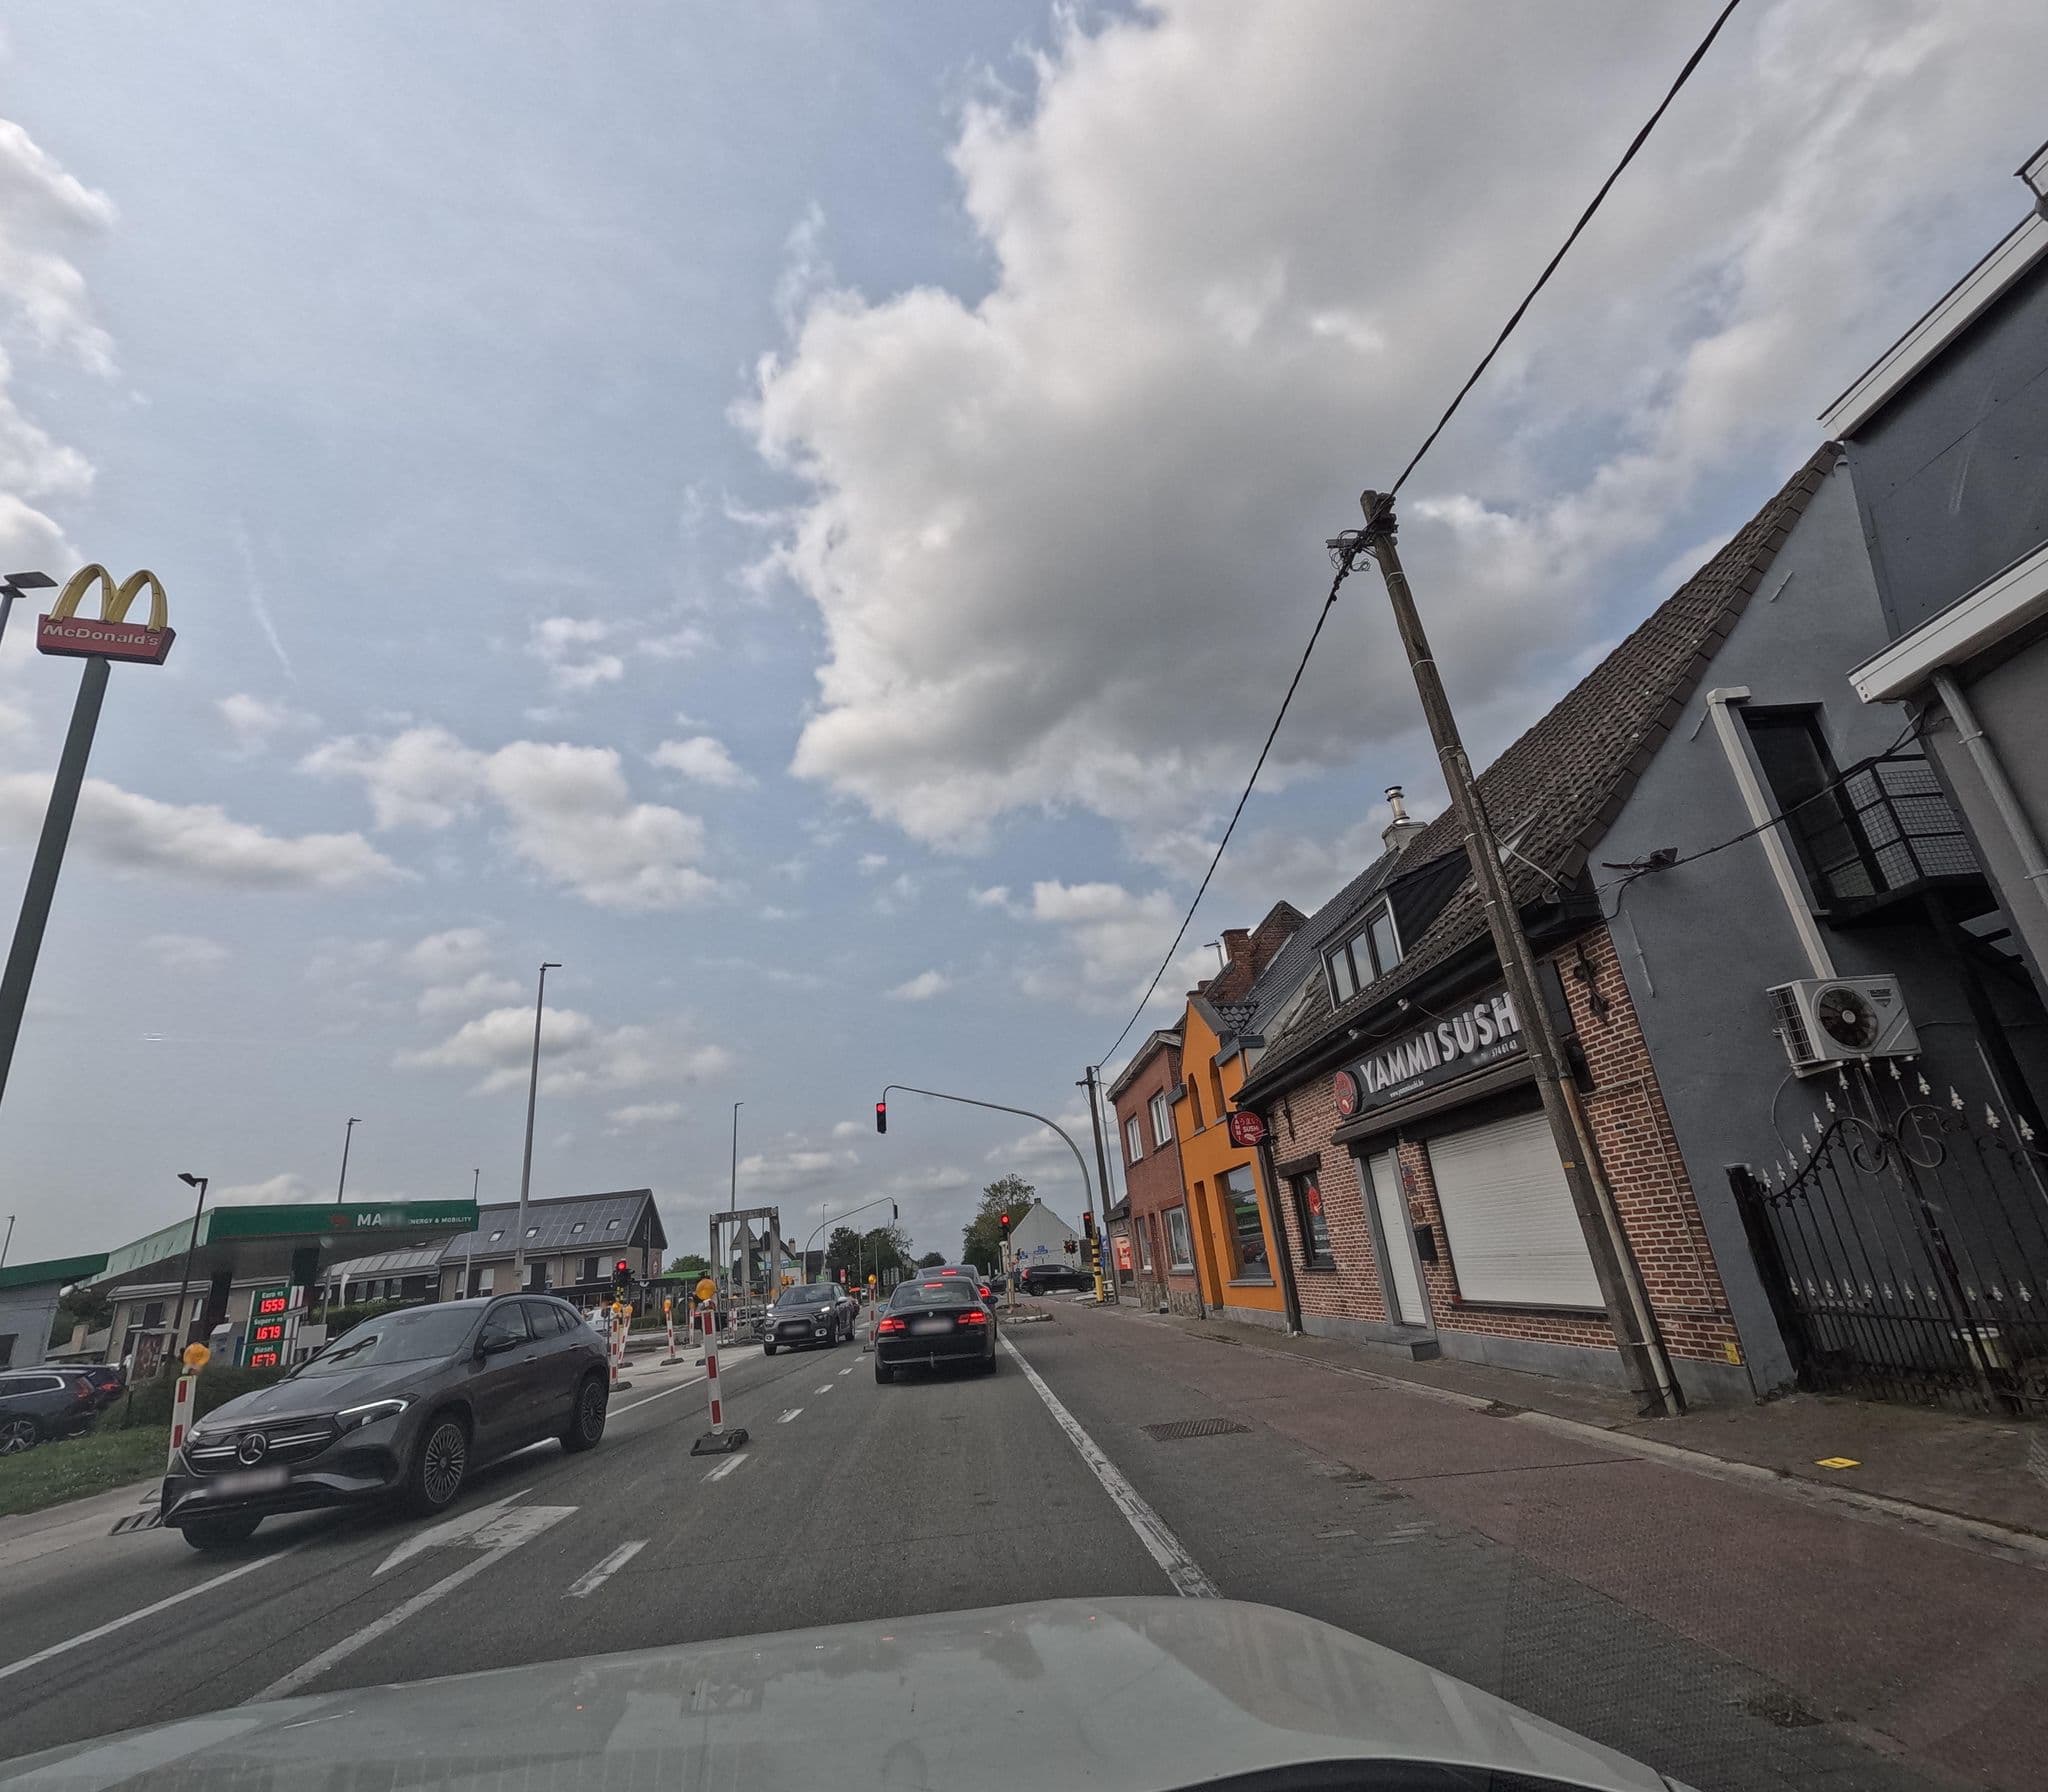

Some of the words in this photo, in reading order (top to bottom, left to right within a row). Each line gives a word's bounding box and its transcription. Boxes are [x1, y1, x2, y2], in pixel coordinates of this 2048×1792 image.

[42, 624, 161, 646] McDonald's
[1360, 1032, 1441, 1094] YAMMI
[1437, 991, 1521, 1062] SUSH
[441, 1216, 472, 1224] MOBILITY
